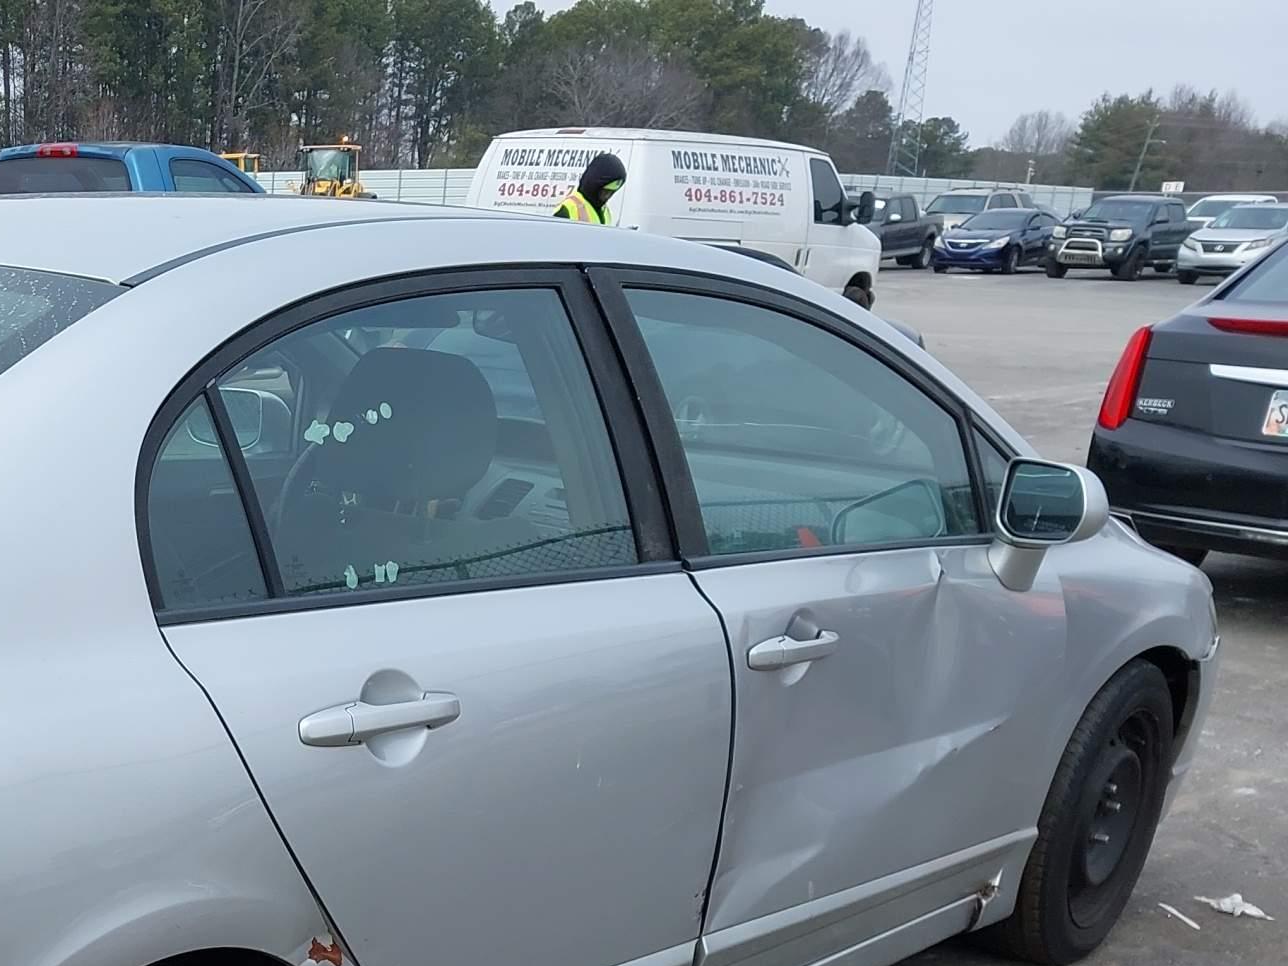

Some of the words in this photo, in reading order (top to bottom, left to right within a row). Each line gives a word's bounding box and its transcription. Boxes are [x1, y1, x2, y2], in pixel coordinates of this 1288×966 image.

[501, 149, 544, 167] MOBILE
[544, 149, 605, 168] MECHAN
[672, 150, 719, 172] MOBILE
[720, 154, 778, 177] MECHANIC
[498, 183, 575, 197] 404-861-7
[684, 188, 785, 206] 404-861-7524
